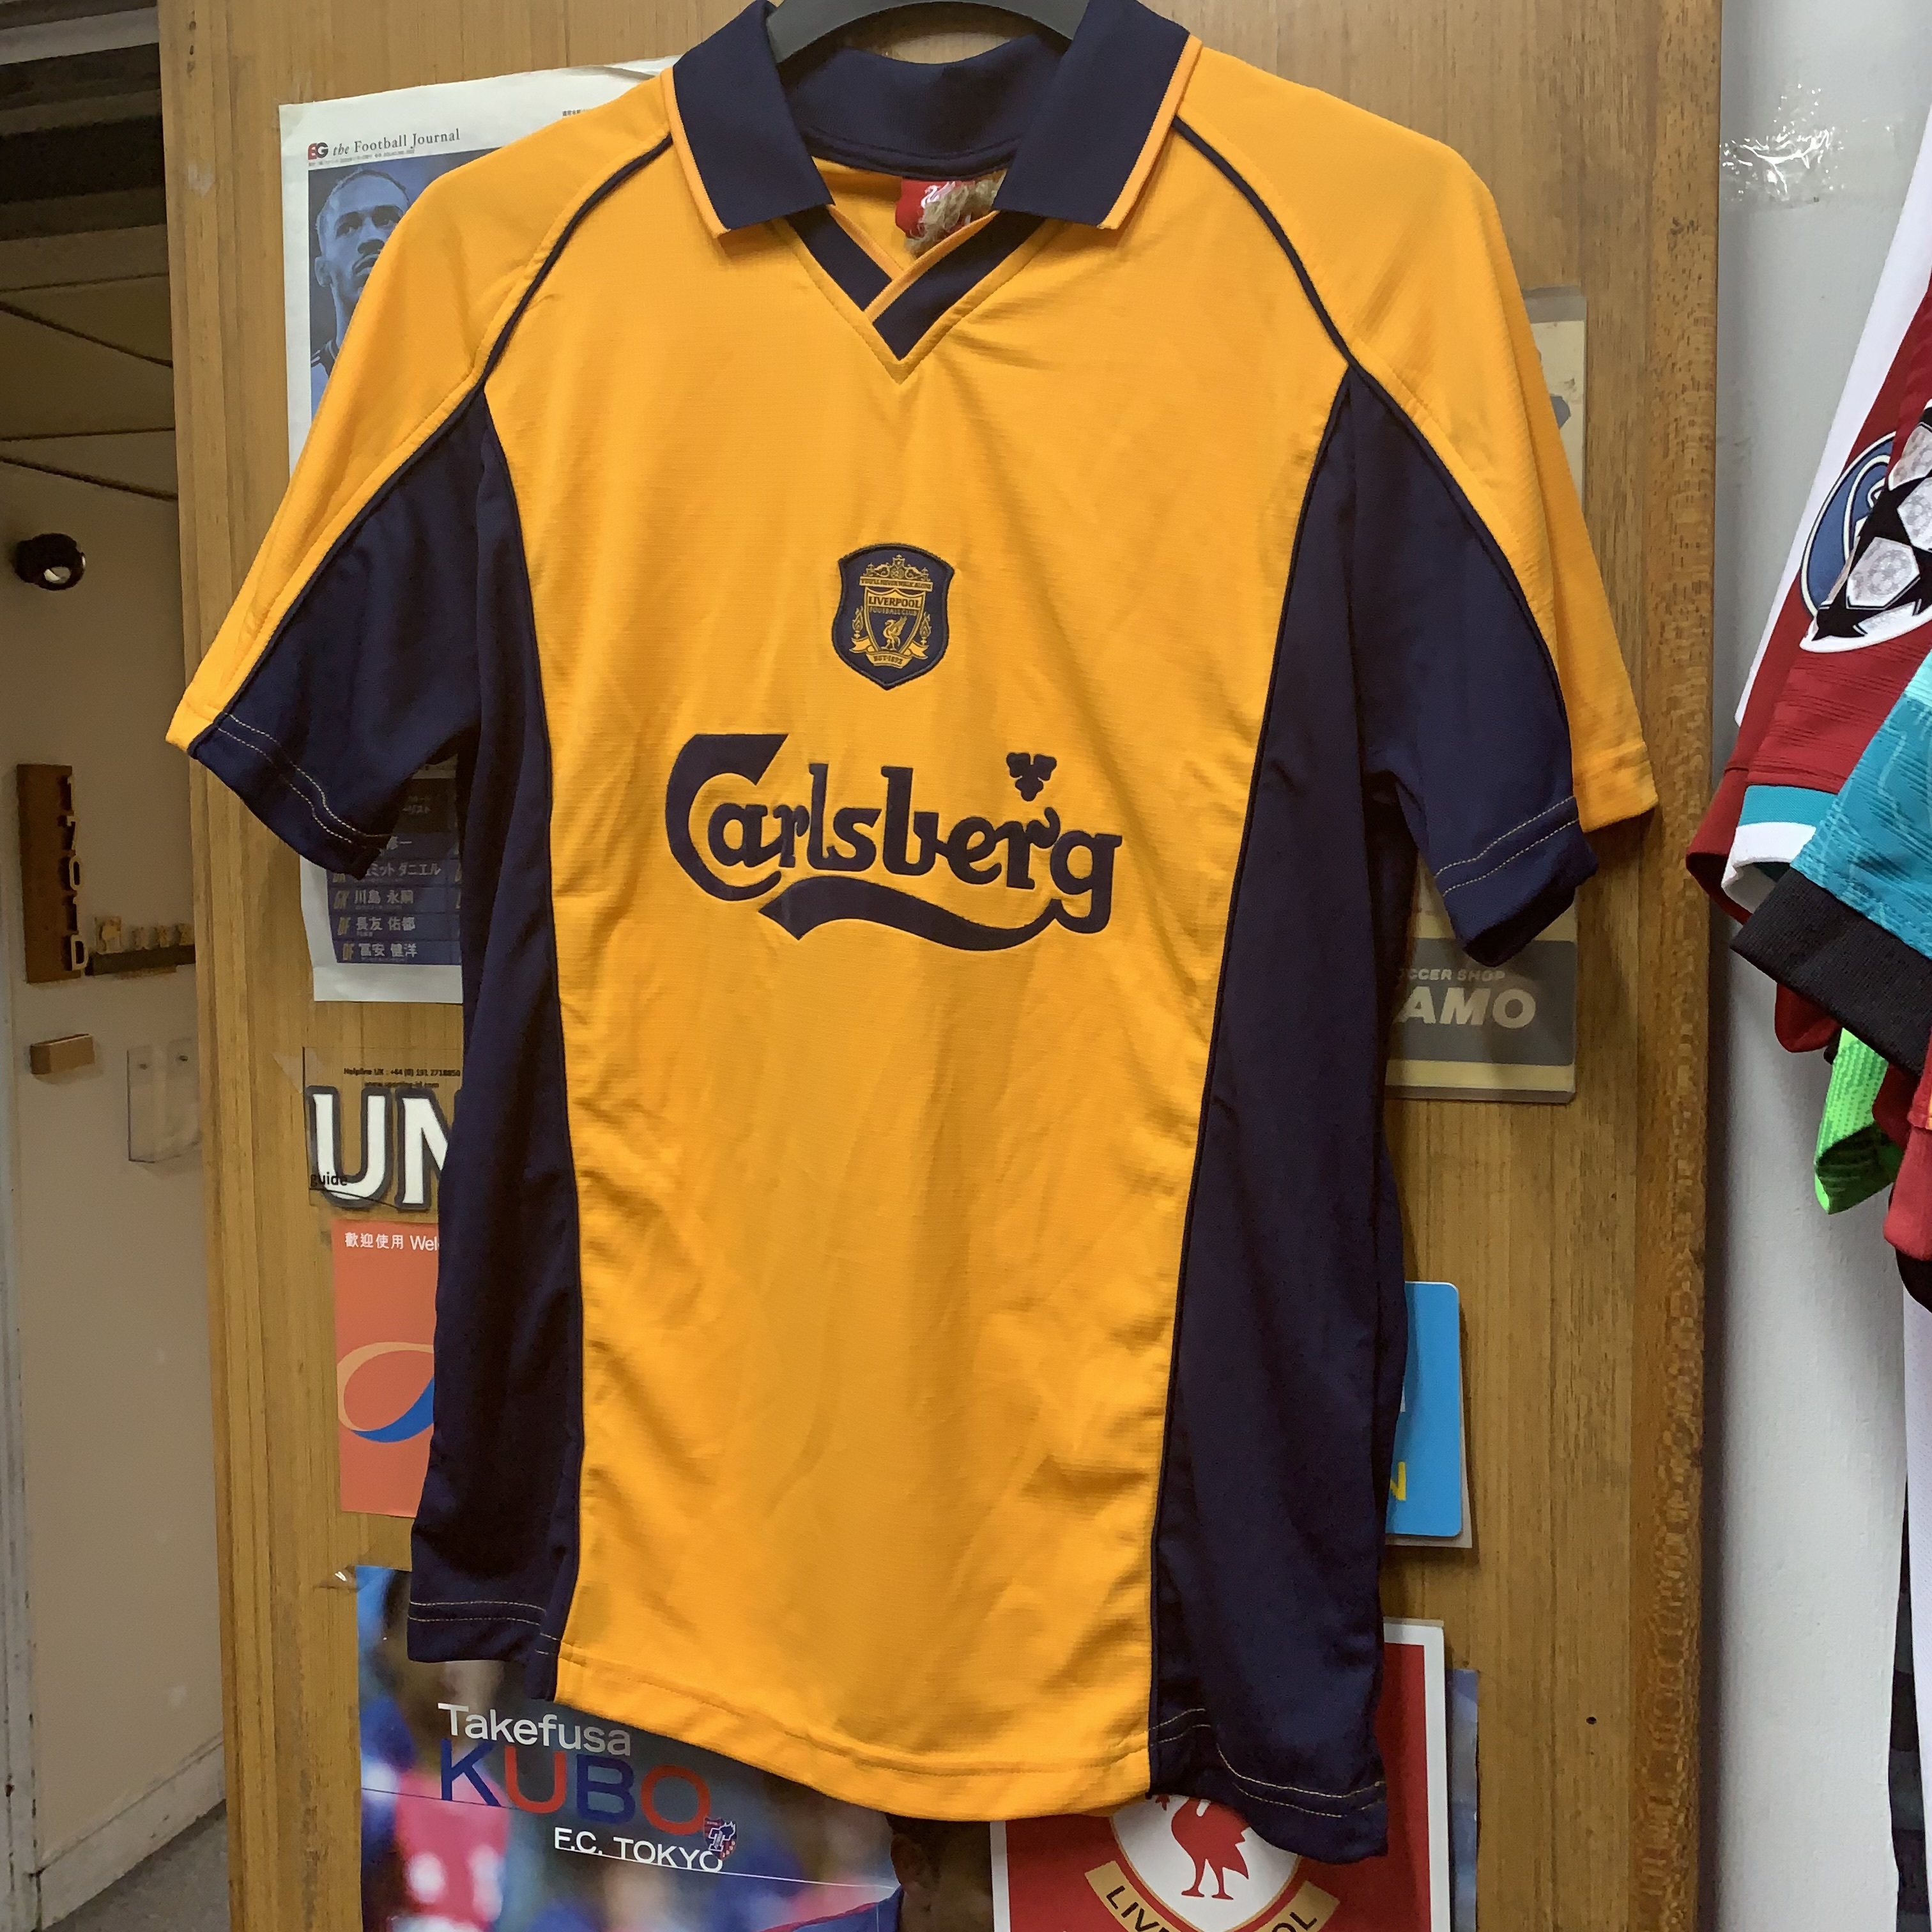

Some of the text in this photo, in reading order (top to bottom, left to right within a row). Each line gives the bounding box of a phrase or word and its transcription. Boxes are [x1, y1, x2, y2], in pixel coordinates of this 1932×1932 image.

[333, 143, 349, 156] the
[354, 134, 407, 153] Football
[410, 128, 460, 150] Journal
[868, 596, 921, 608] LIVERPOOL
[869, 606, 901, 615] FOOTBALL
[666, 733, 1123, 951] Carlsberg
[1407, 968, 1506, 982] CCER SHOP
[310, 1172, 348, 1187] guide
[344, 1232, 440, 1252] 歡迎使用 Wel
[437, 1702, 631, 1757] Takefusa
[440, 1738, 711, 1836] KUBO
[553, 1827, 603, 1856] F.C.
[613, 1836, 723, 1873] TOKYO
